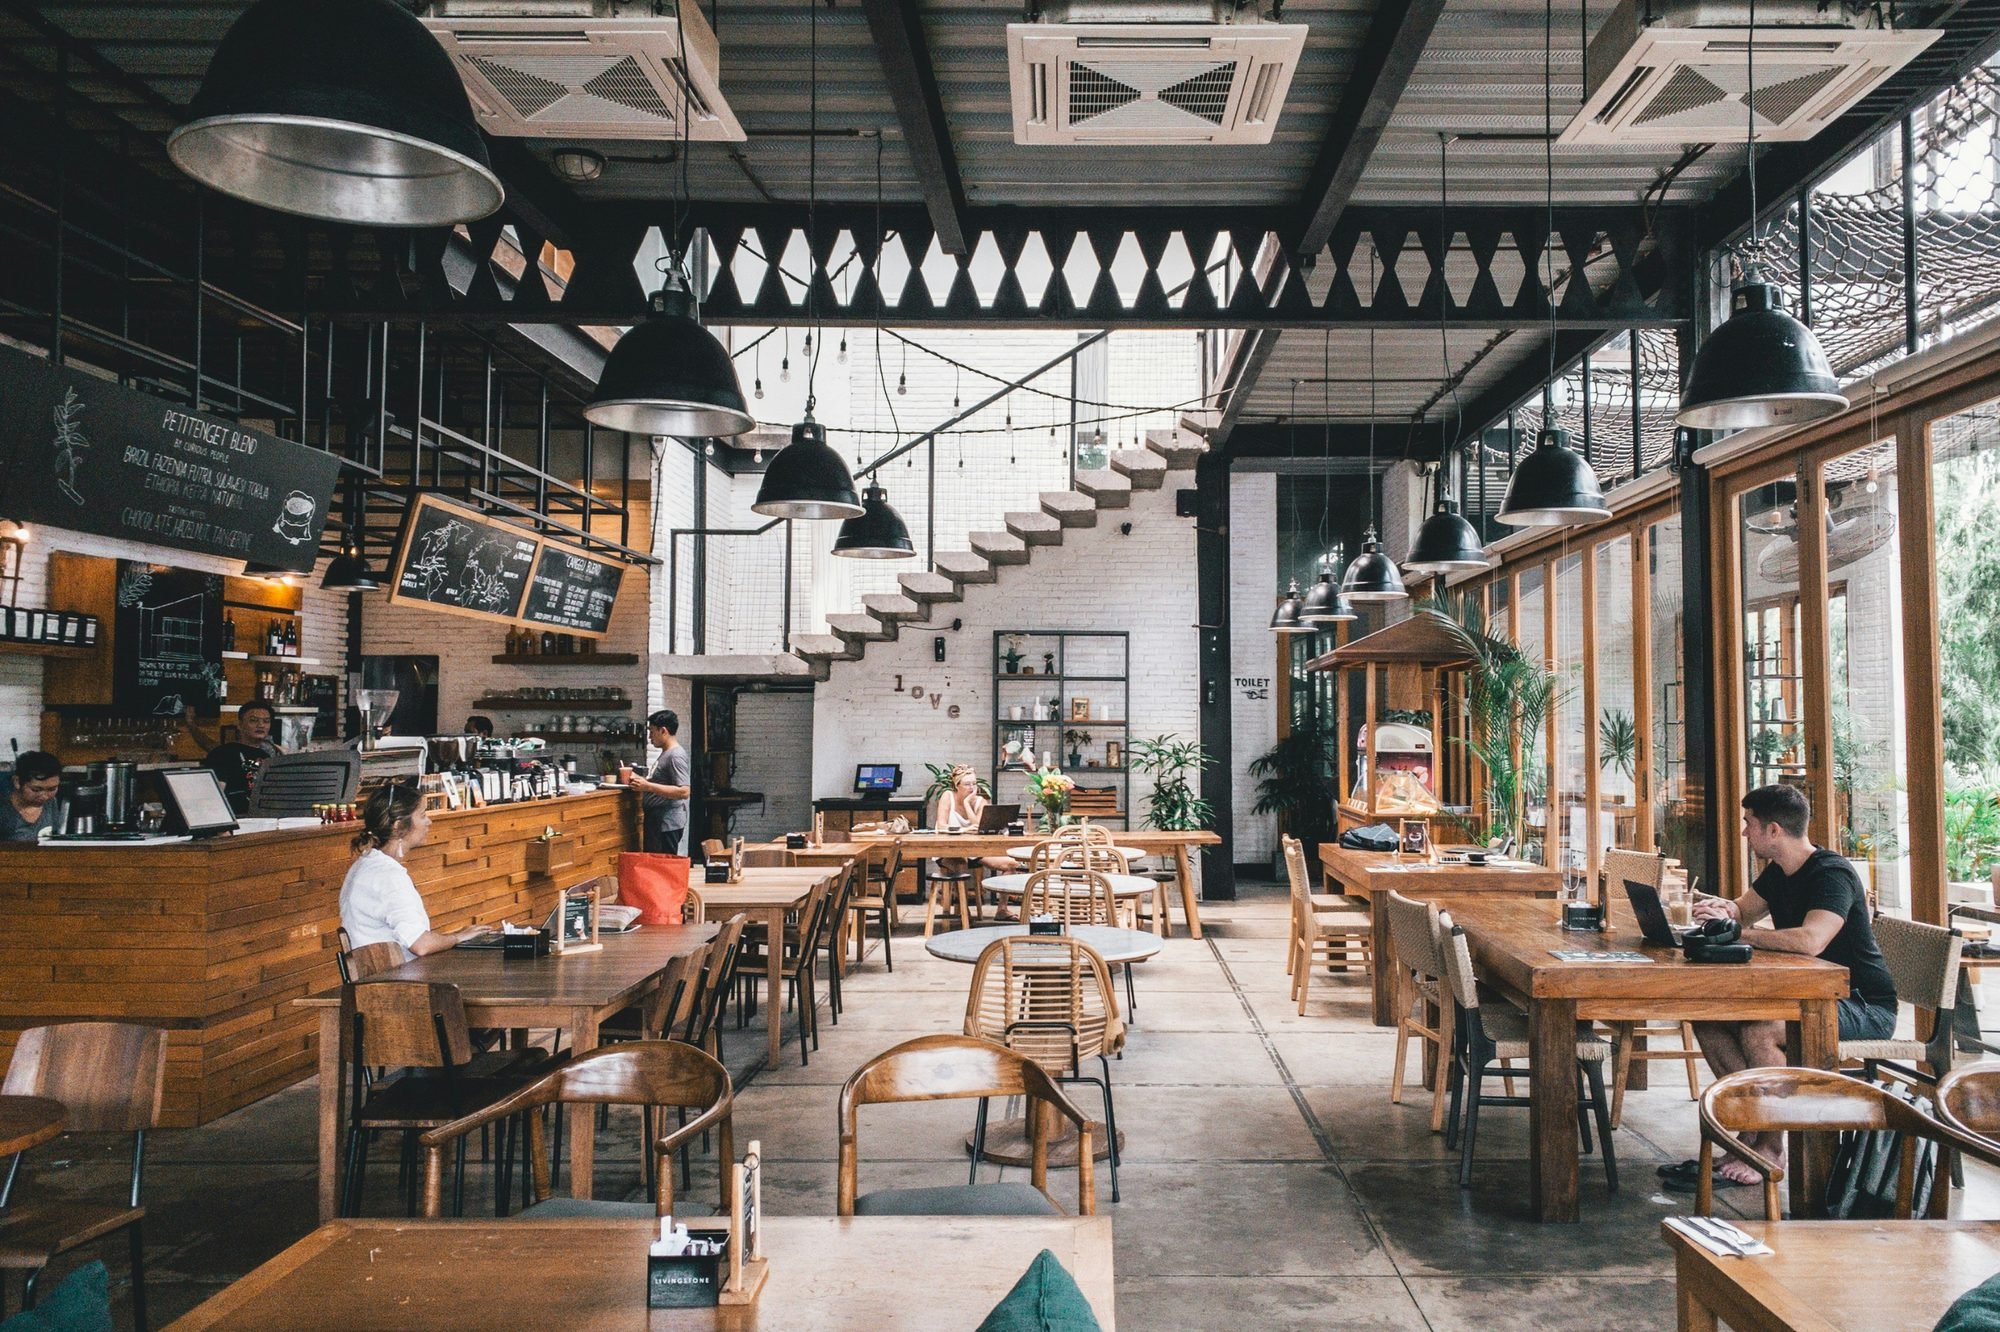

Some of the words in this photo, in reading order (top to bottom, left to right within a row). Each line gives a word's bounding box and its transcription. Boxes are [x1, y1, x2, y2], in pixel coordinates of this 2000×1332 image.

[162, 409, 229, 447] PETITENGET
[229, 430, 258, 456] BLEND
[122, 445, 149, 468] BRAZIL
[1234, 678, 1270, 687] TOILET
[894, 674, 960, 719] love
[655, 1277, 710, 1285] LIVINGSTONE
